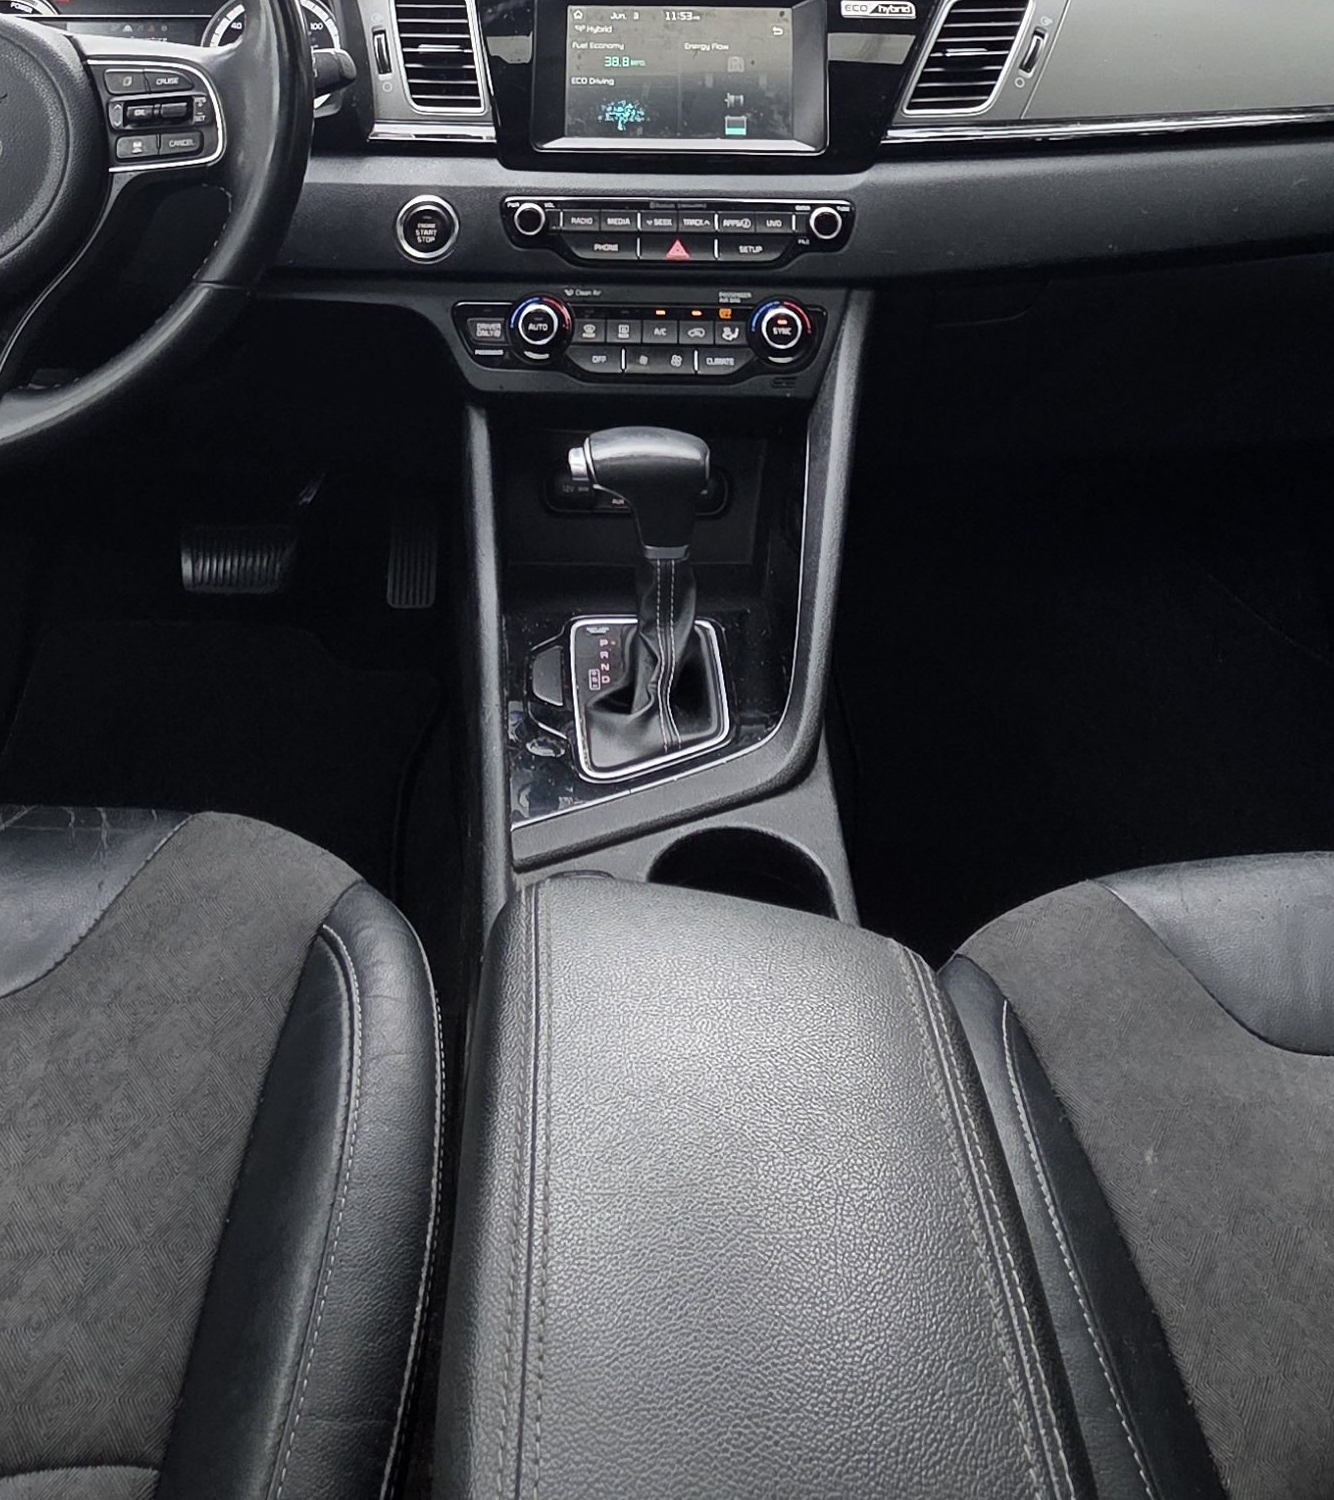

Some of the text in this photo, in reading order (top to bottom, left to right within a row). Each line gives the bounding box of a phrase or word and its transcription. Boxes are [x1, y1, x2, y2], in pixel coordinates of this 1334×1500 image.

[844, 3, 913, 15] ECO hybrid
[610, 11, 628, 20] Jun.
[633, 11, 640, 20] 3
[586, 25, 613, 34] Hybrid
[571, 41, 625, 51] Fuel Economy
[684, 42, 730, 52] Energy Flow
[604, 56, 630, 68] 38.8
[155, 77, 179, 86] CRUISE
[571, 77, 615, 86] ECO Driving
[168, 138, 196, 148] CANCEL
[570, 216, 594, 225] RADIO
[606, 217, 631, 226] MEDIA
[415, 229, 438, 237] START
[593, 243, 619, 252] PHONE
[738, 244, 763, 254] SETUP
[574, 289, 592, 297] Clean
[528, 322, 549, 332] AUTO
[653, 327, 667, 336] A/C
[591, 355, 607, 364] OFF
[599, 638, 609, 647] P
[600, 663, 610, 671] N
[601, 675, 611, 684] D
